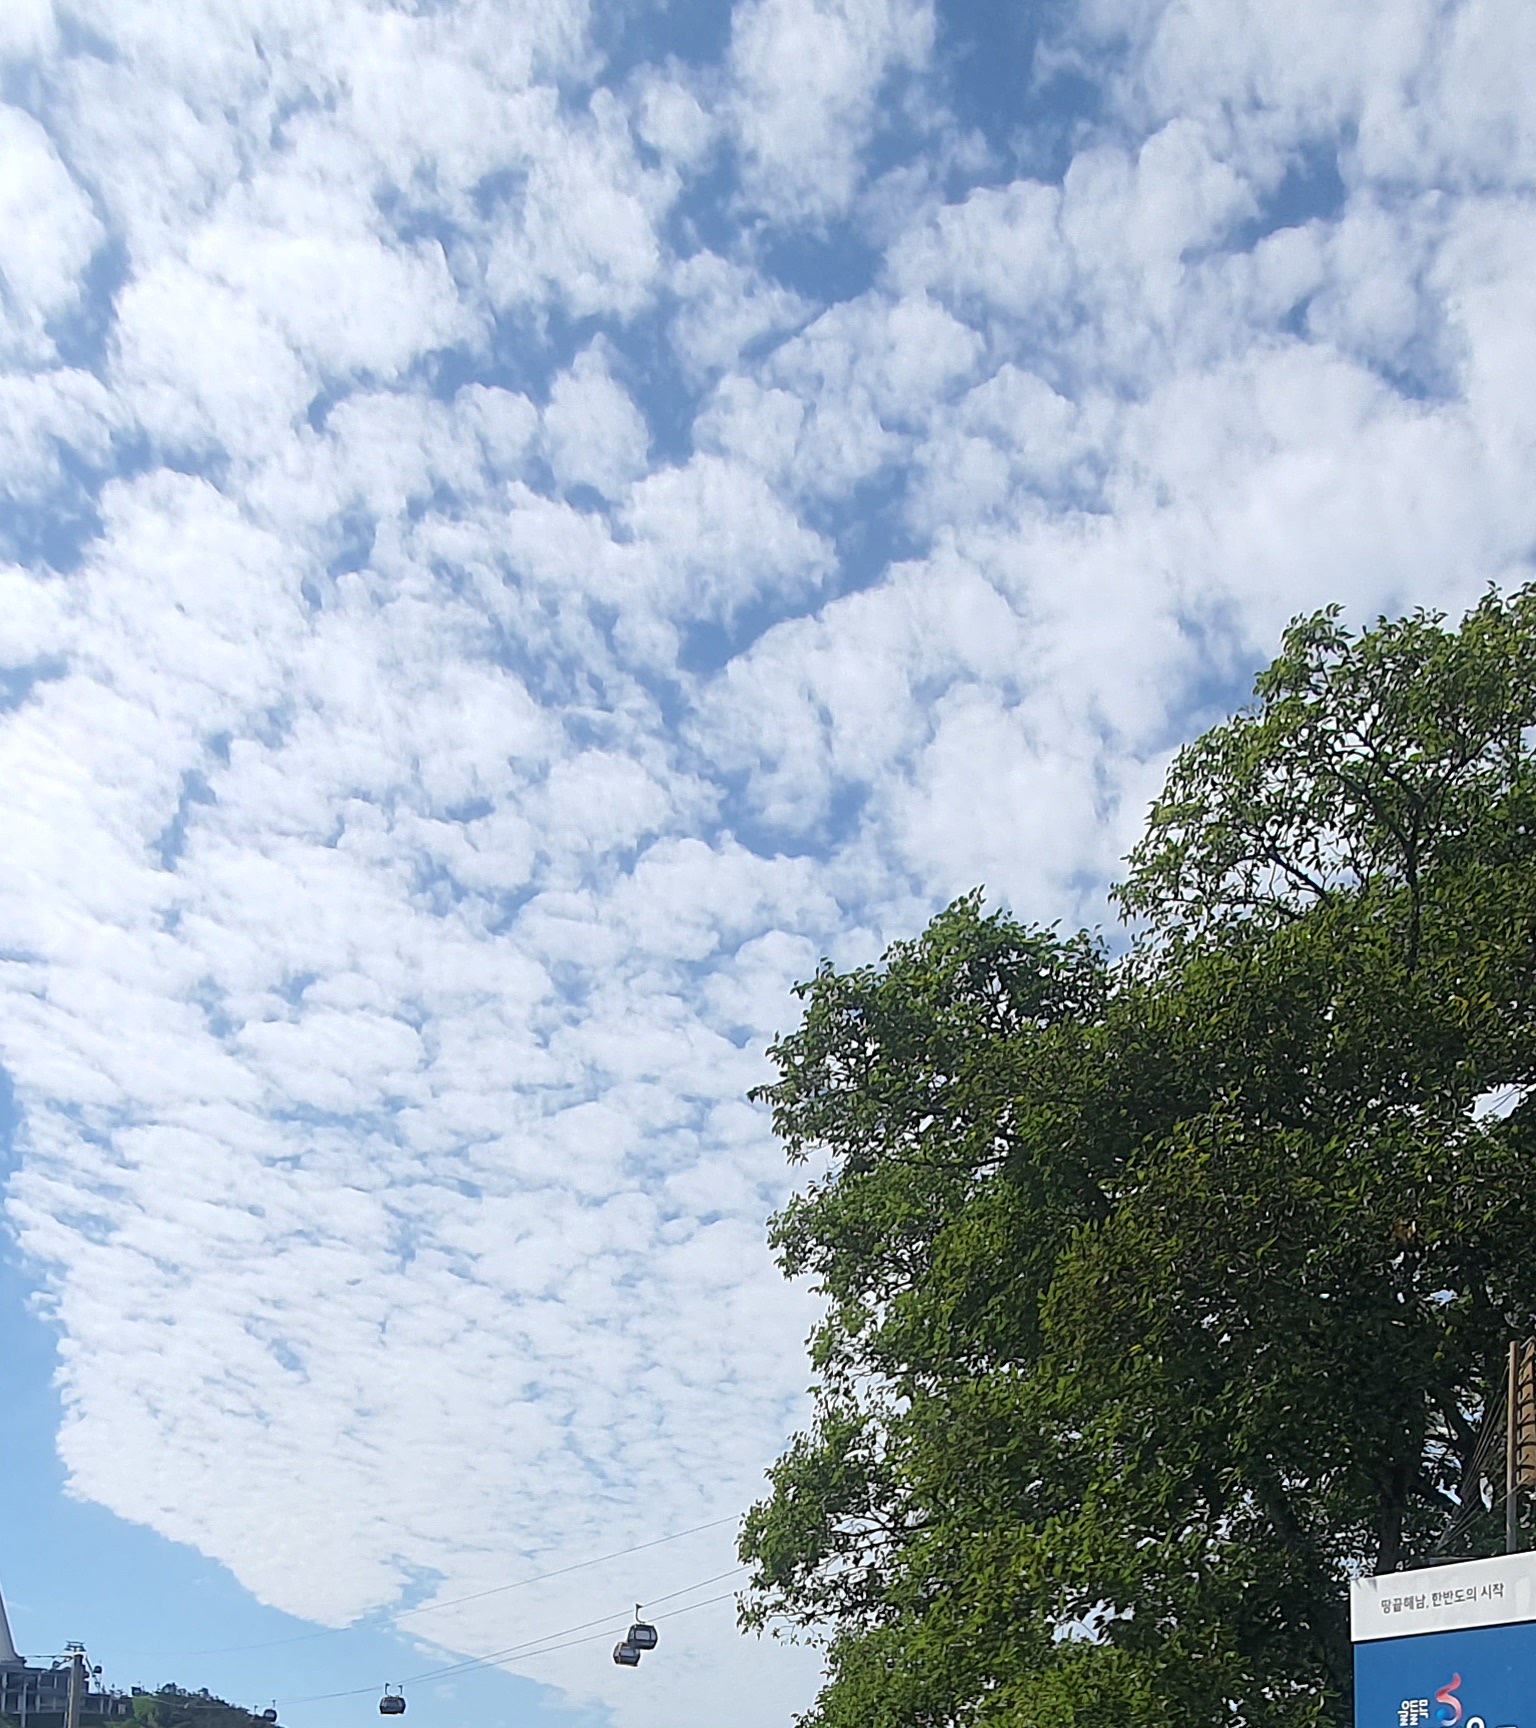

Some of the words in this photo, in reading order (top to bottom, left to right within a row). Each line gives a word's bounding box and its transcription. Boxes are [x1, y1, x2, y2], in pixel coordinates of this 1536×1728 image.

[1381, 1593, 1429, 1614] 땅끝해남,
[1432, 1586, 1477, 1608] 한반도의
[1481, 1582, 1505, 1599] 시작
[1397, 1699, 1429, 1727] 울돌목
